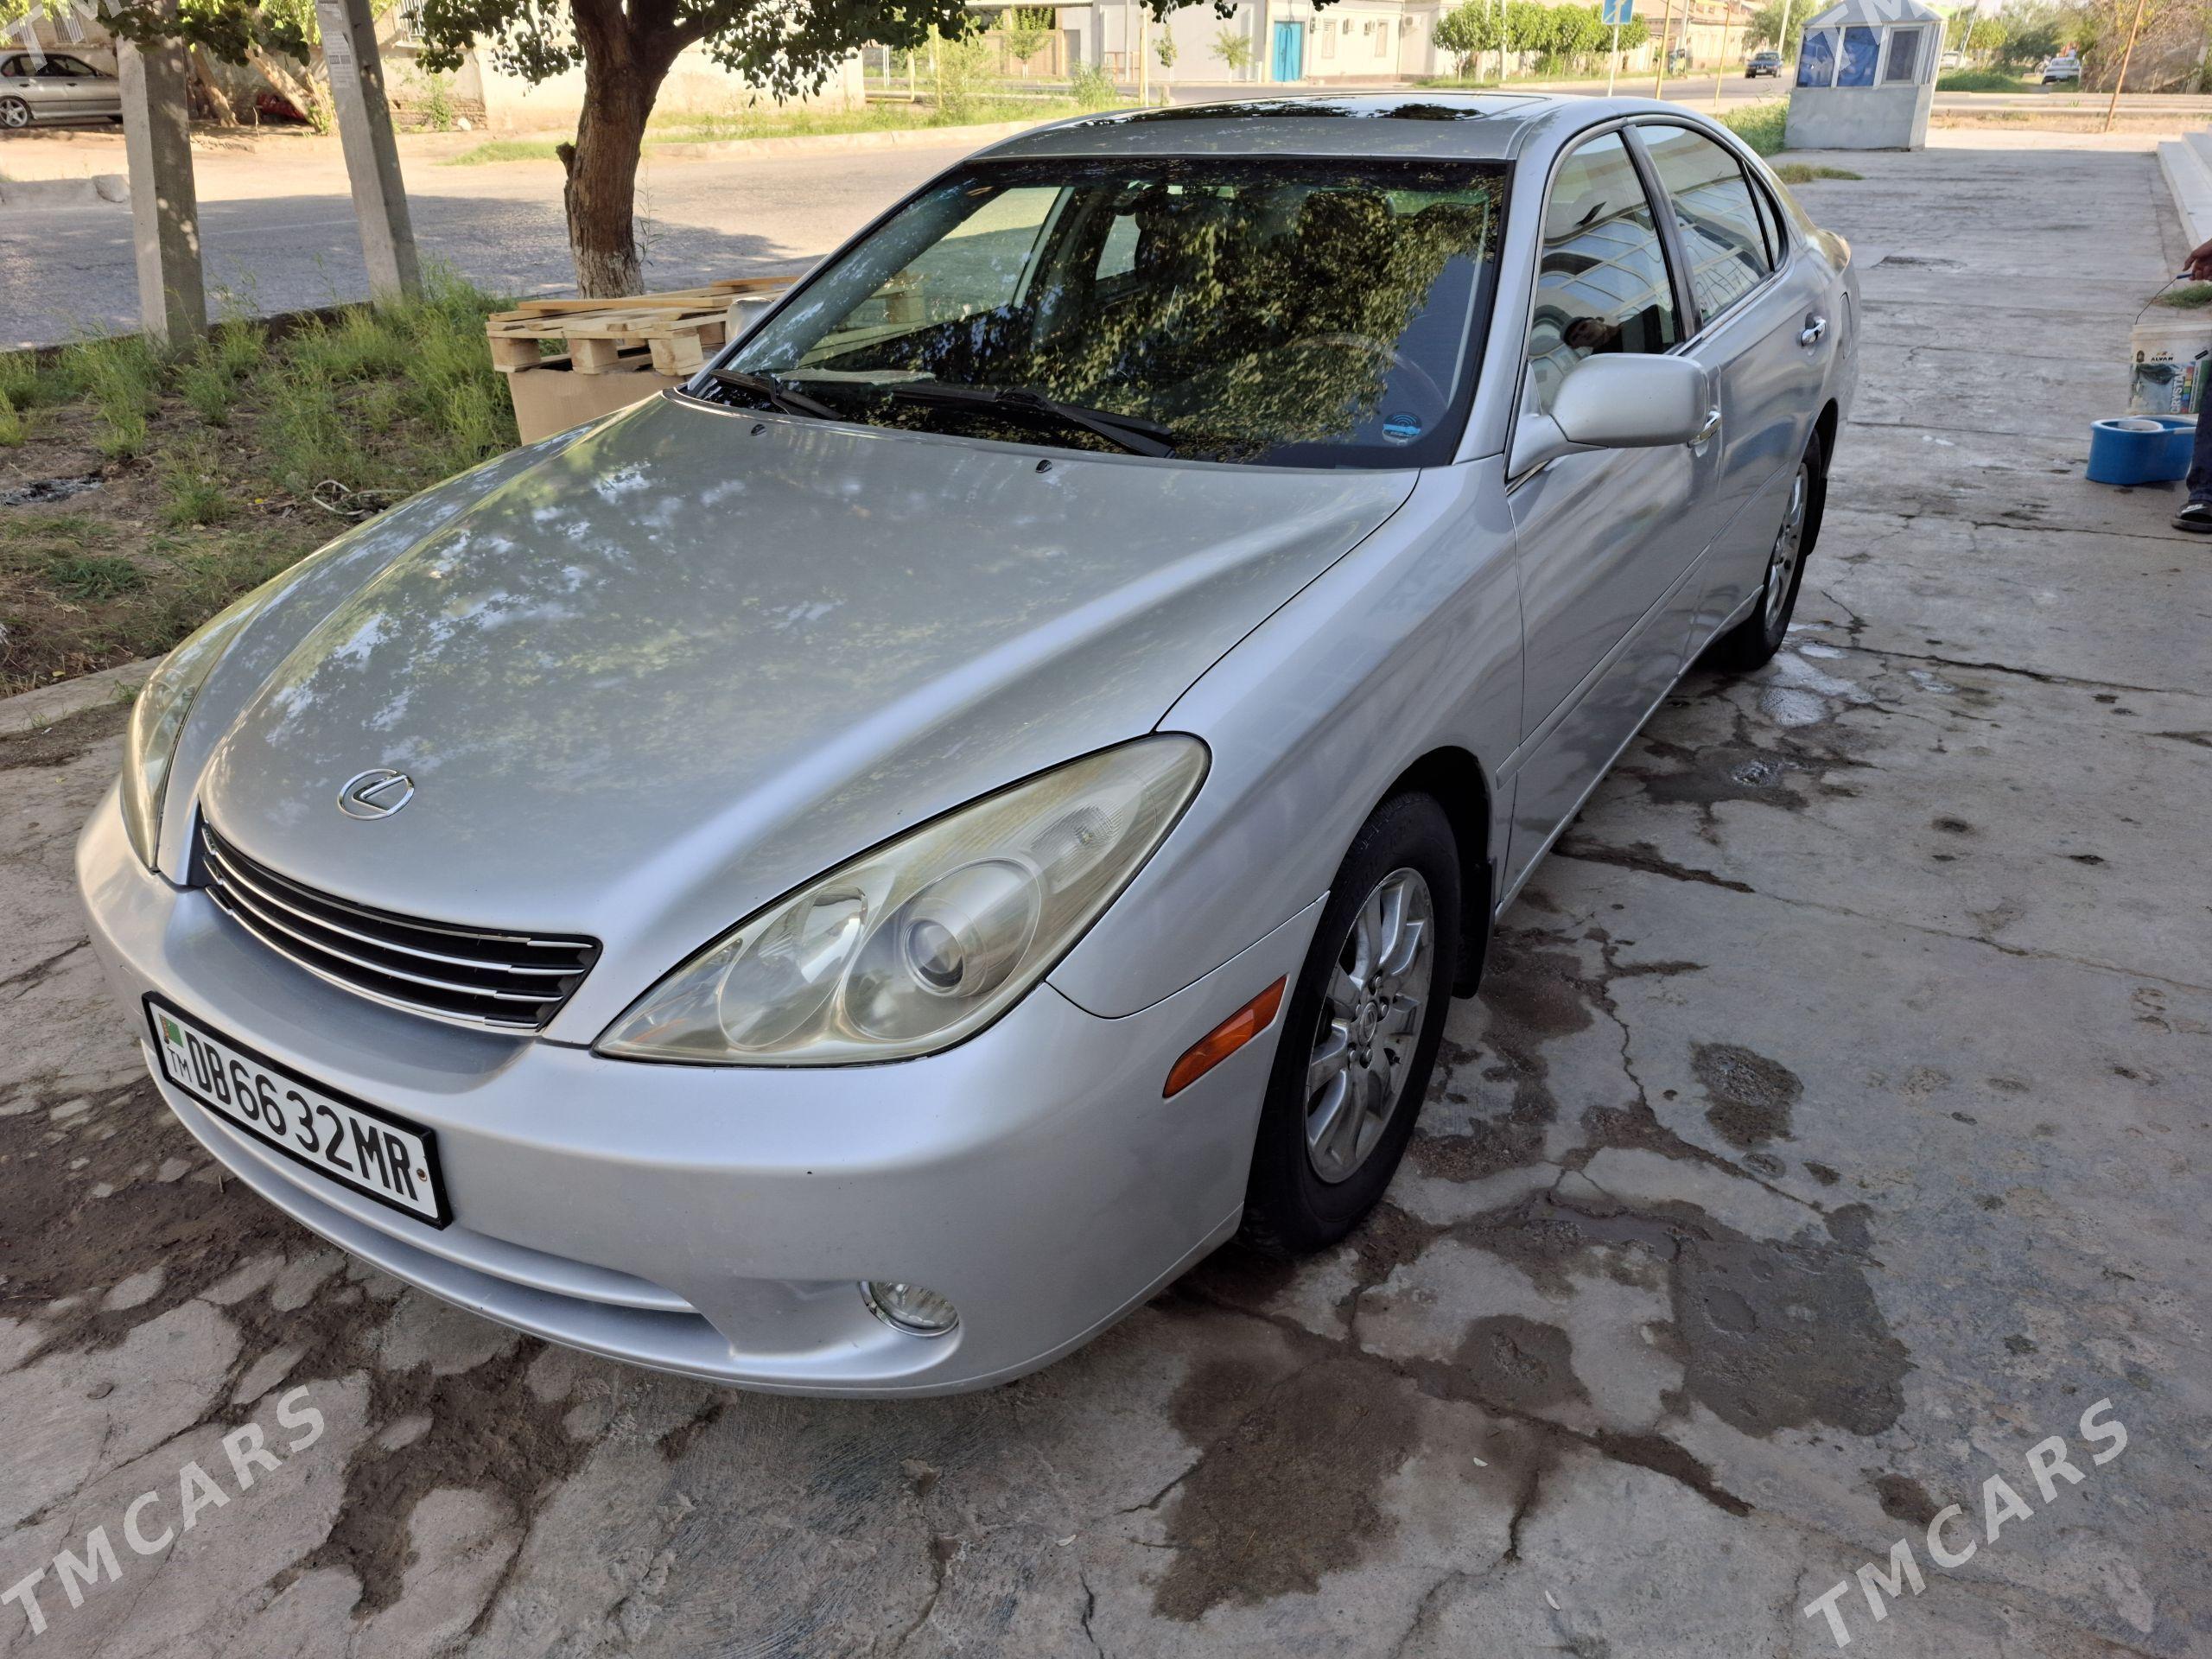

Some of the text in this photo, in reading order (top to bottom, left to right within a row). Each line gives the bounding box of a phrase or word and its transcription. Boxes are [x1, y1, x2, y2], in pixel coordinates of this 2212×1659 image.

[2170, 367, 2186, 413] CRYSTAL
[167, 1046, 192, 1084] TM
[184, 1030, 418, 1202] DB6632MR
